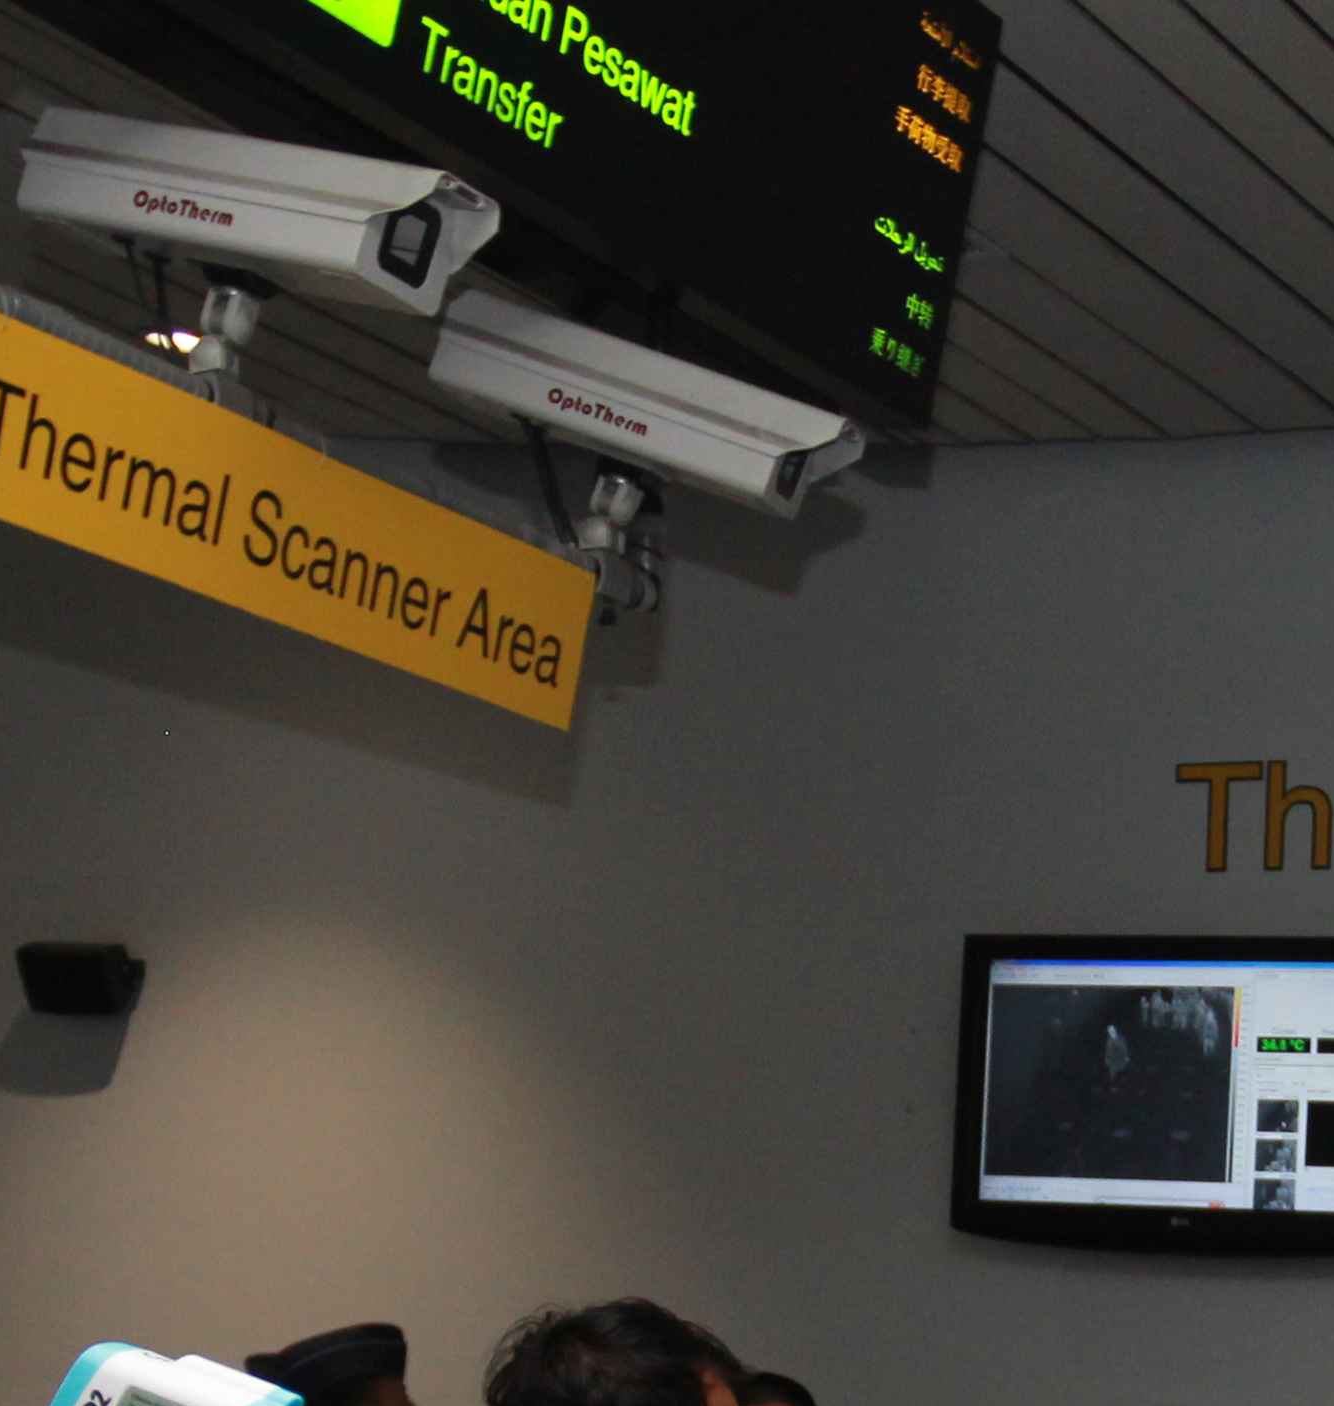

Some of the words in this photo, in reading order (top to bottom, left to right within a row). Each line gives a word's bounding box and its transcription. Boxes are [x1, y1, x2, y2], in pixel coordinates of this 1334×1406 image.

[421, 15, 564, 149] Transfer
[559, 5, 697, 137] Pesawat
[133, 190, 234, 226] OptoTherm
[548, 388, 648, 436] OptoTherm
[243, 489, 453, 637] Scanner
[456, 587, 562, 689] Area
